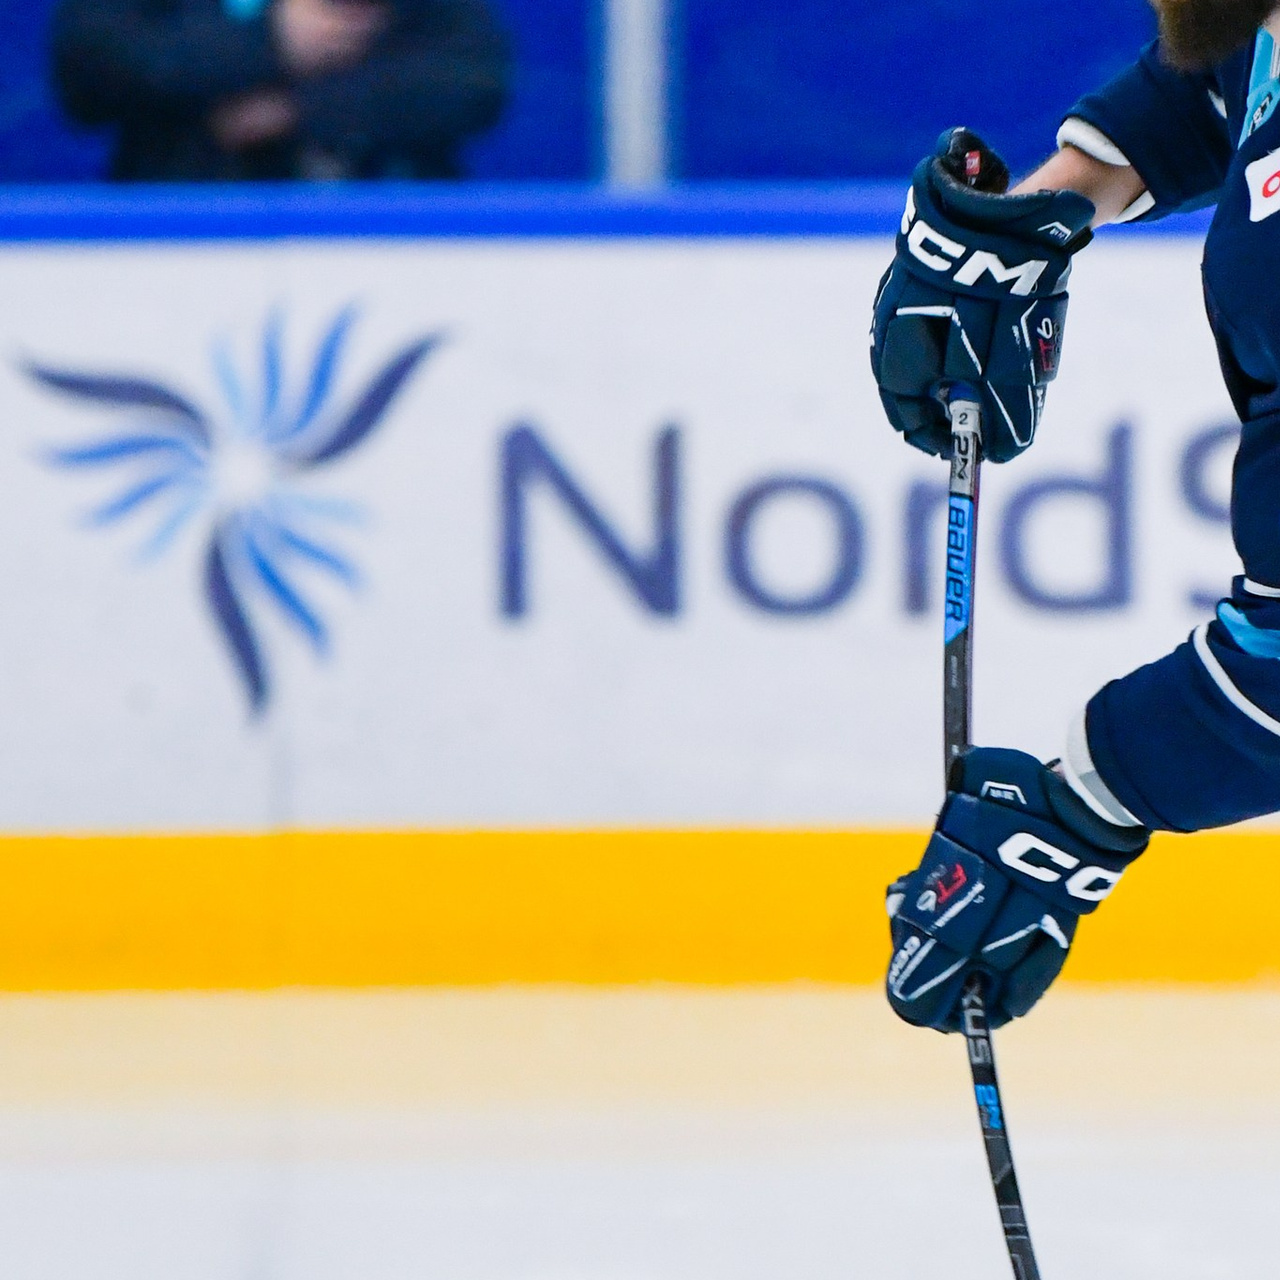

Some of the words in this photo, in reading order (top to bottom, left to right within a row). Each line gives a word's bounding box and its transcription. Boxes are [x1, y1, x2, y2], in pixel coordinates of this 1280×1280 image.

[958, 412, 969, 425] 2
[997, 832, 1123, 902] CC
[961, 983, 992, 1065] XUS
